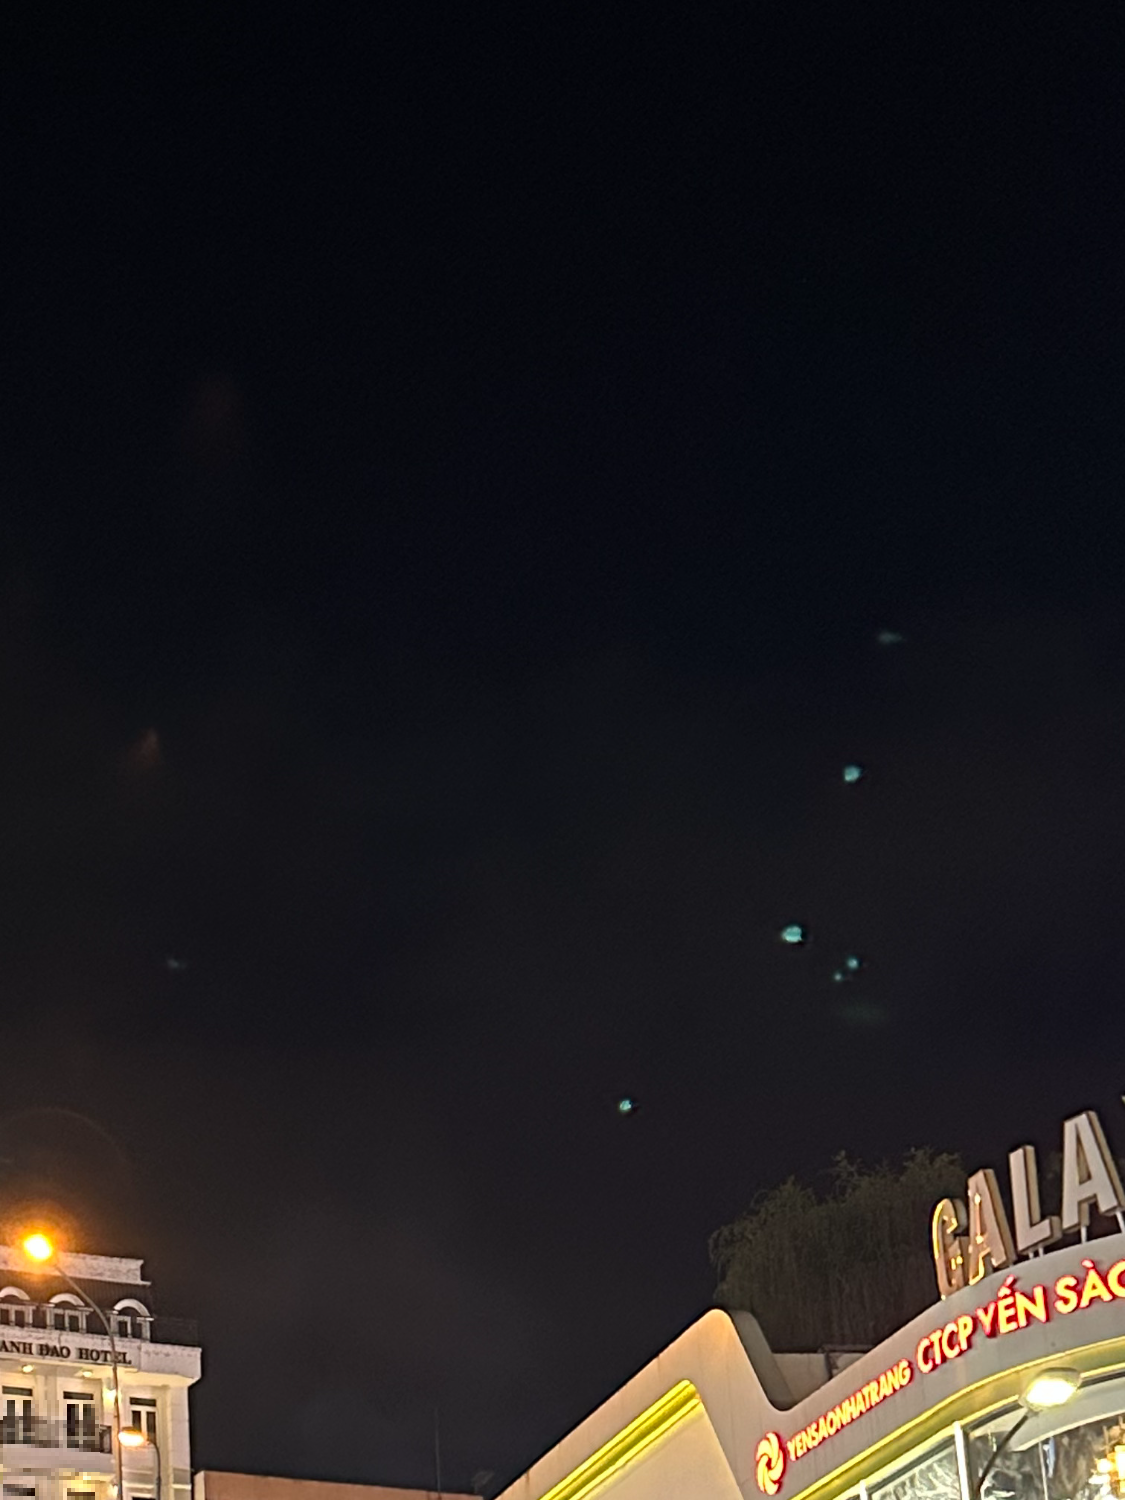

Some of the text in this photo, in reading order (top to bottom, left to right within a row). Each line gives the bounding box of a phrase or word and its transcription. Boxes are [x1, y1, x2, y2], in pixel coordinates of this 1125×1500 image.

[932, 1096, 1125, 1301] GALA
[0, 1340, 34, 1356] ANH
[77, 1347, 132, 1365] HOTEL
[916, 1314, 974, 1374] CTCP
[975, 1274, 1049, 1338] YẾN
